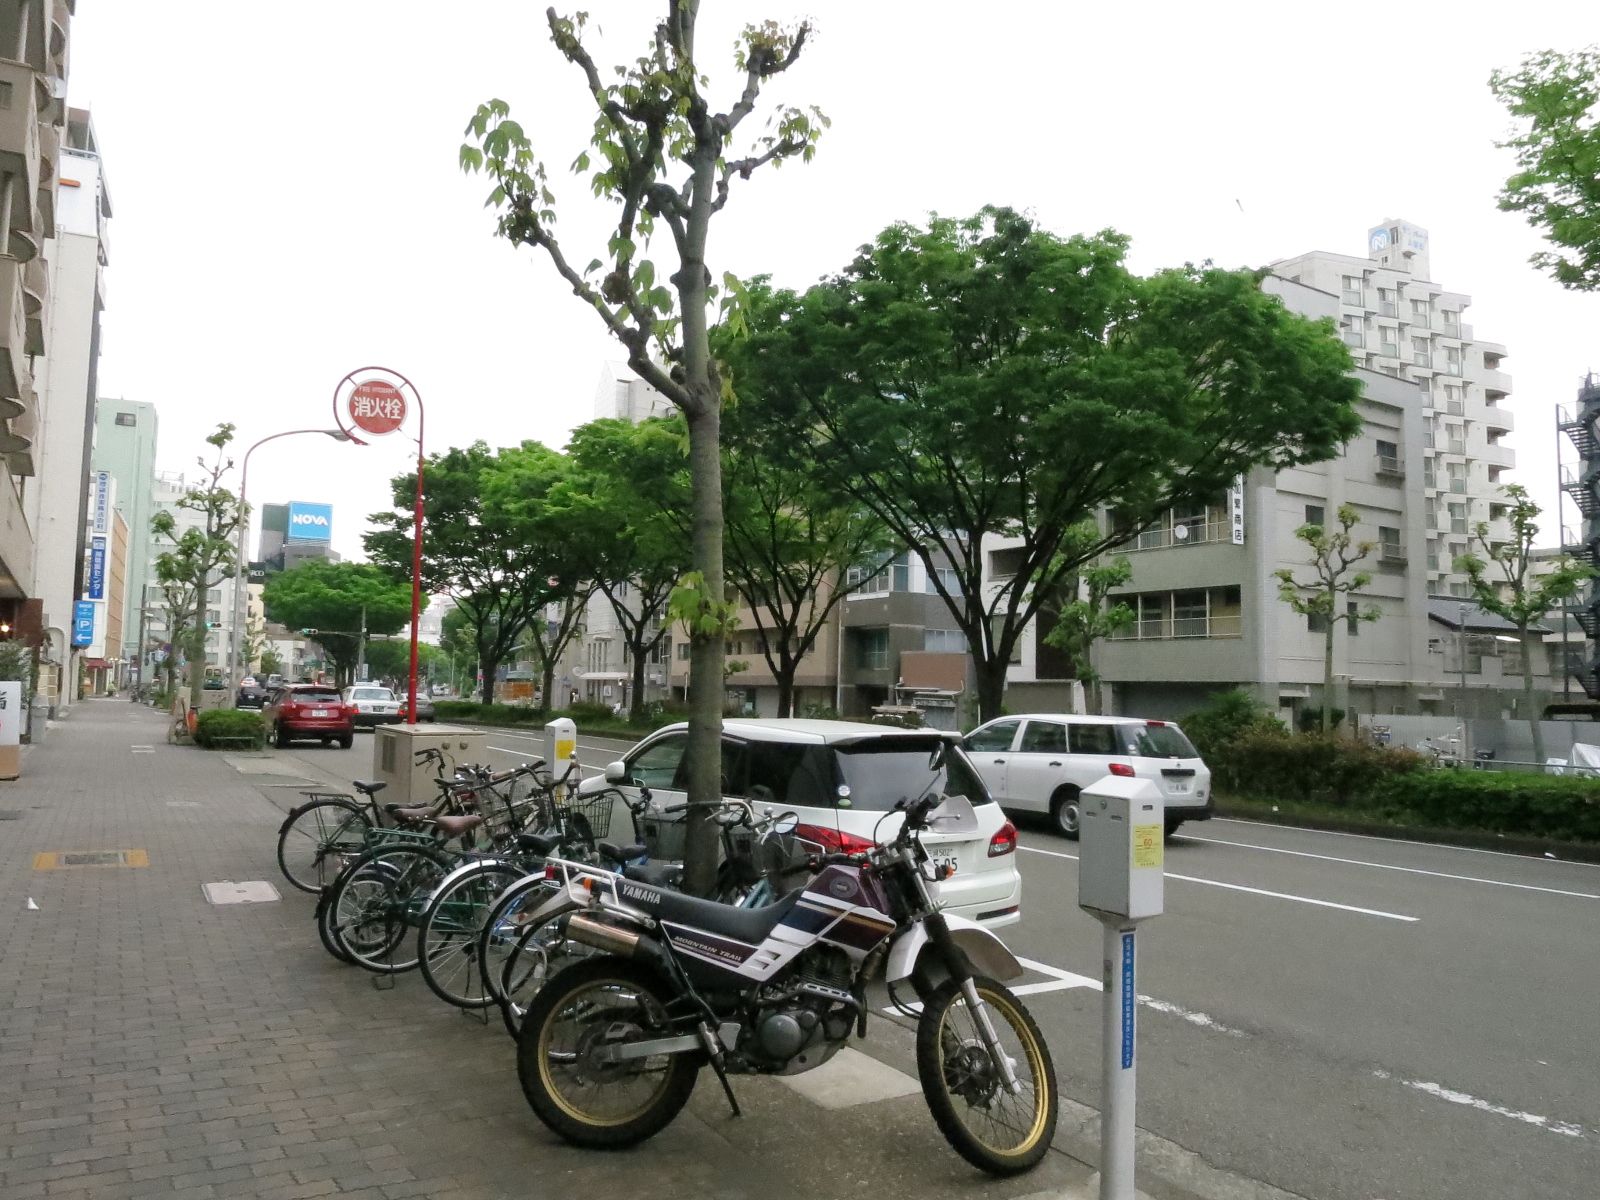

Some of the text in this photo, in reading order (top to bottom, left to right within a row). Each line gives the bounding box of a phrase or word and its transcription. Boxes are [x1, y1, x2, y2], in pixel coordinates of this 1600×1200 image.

[354, 396, 402, 420] 消火栓
[293, 514, 328, 526] NOVA
[80, 620, 90, 629] P
[622, 884, 661, 904] YAMAHA
[674, 936, 718, 953] MOUNTAIN
